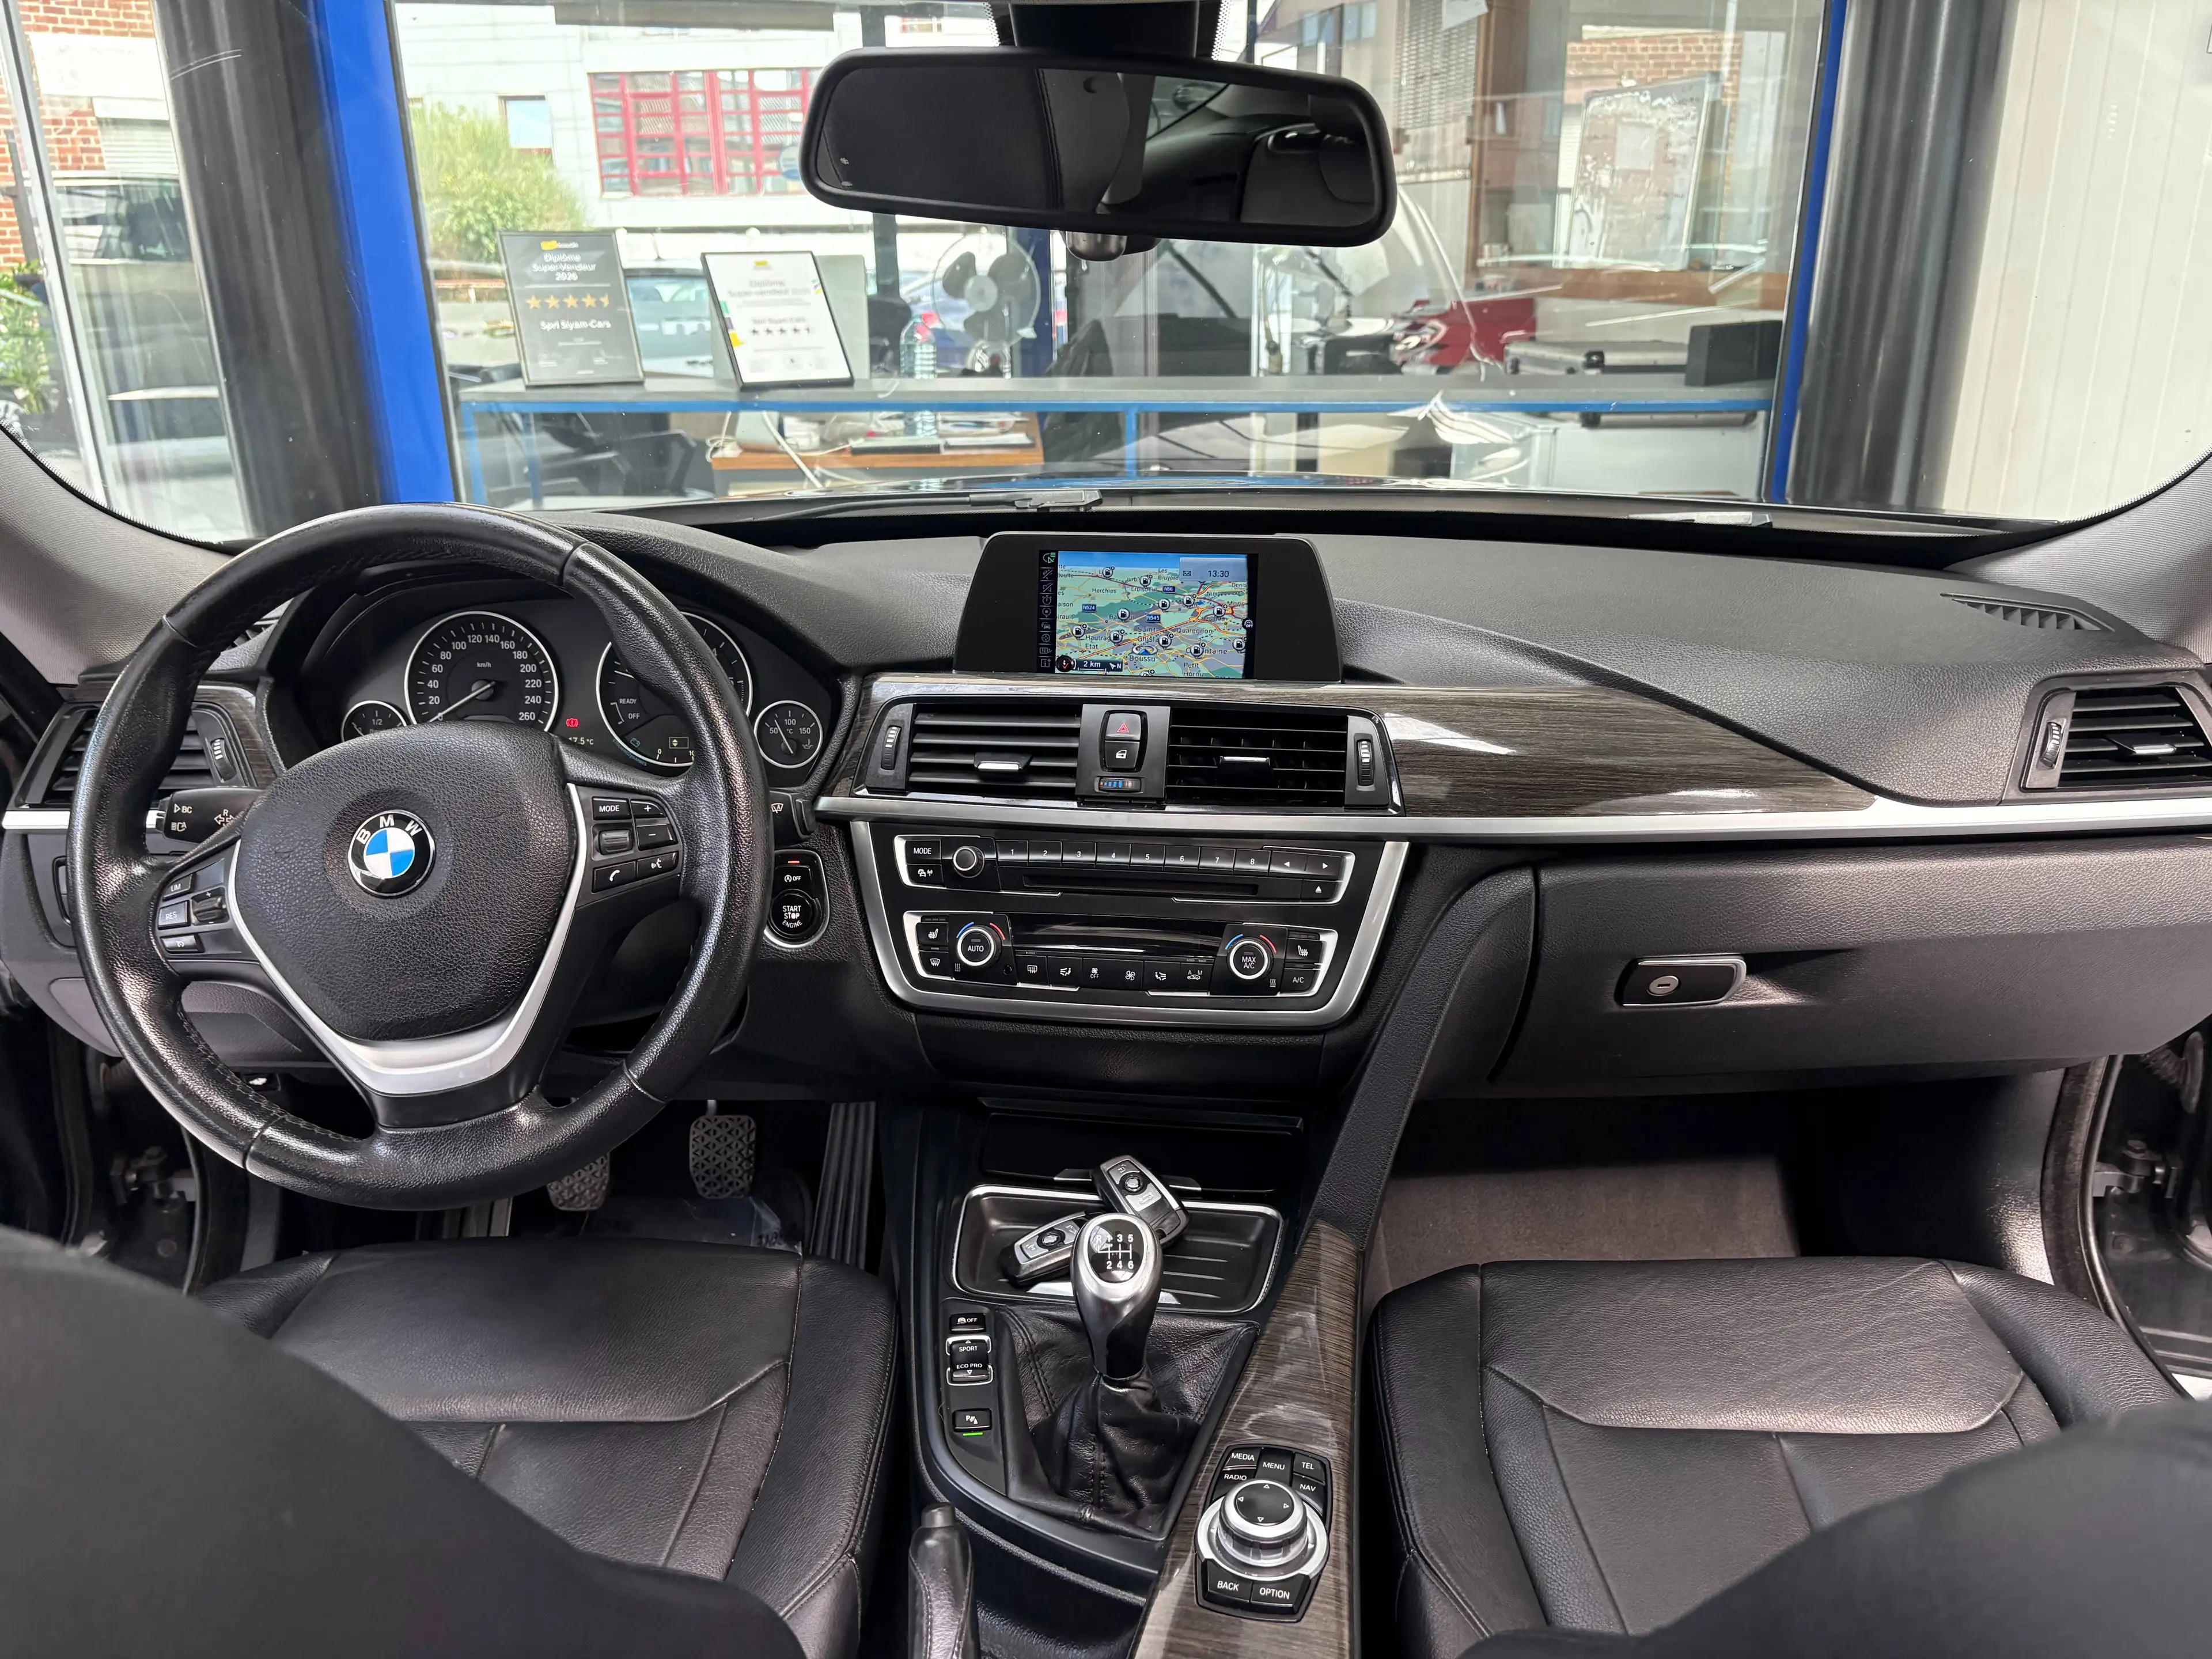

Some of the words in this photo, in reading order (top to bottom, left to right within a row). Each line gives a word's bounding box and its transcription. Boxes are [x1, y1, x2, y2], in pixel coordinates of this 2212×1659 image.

[468, 635, 482, 643] 120
[484, 635, 499, 643] 140
[452, 641, 467, 650] 100
[500, 641, 515, 649] 160
[440, 651, 452, 660] 80
[512, 651, 528, 660] 180
[431, 664, 444, 673] 60
[520, 664, 537, 673] 200
[427, 680, 439, 688] 40
[525, 679, 542, 688] 220
[429, 696, 440, 704] 20
[524, 695, 541, 704] 240
[518, 711, 536, 721] 260
[181, 805, 193, 814] BC
[355, 814, 422, 844] BMW
[913, 847, 931, 855] MODE
[171, 882, 181, 891] LIM
[165, 911, 177, 921] RES
[782, 919, 802, 929] ENGINE
[967, 945, 984, 953] AUTO
[1292, 976, 1304, 984] A/C
[1096, 1234, 1102, 1243] R
[1116, 1234, 1123, 1243] 3
[1127, 1234, 1134, 1243] 5
[1106, 1261, 1112, 1270] 2
[1116, 1261, 1123, 1270] 4
[1127, 1261, 1134, 1270] 6
[1231, 1452, 1255, 1461] MEDIA
[1263, 1461, 1285, 1470] MENU
[1301, 1461, 1315, 1469] TEL
[1300, 1483, 1316, 1492] NAV
[1217, 1580, 1239, 1592] BACK
[1259, 1586, 1290, 1600] OPTION
